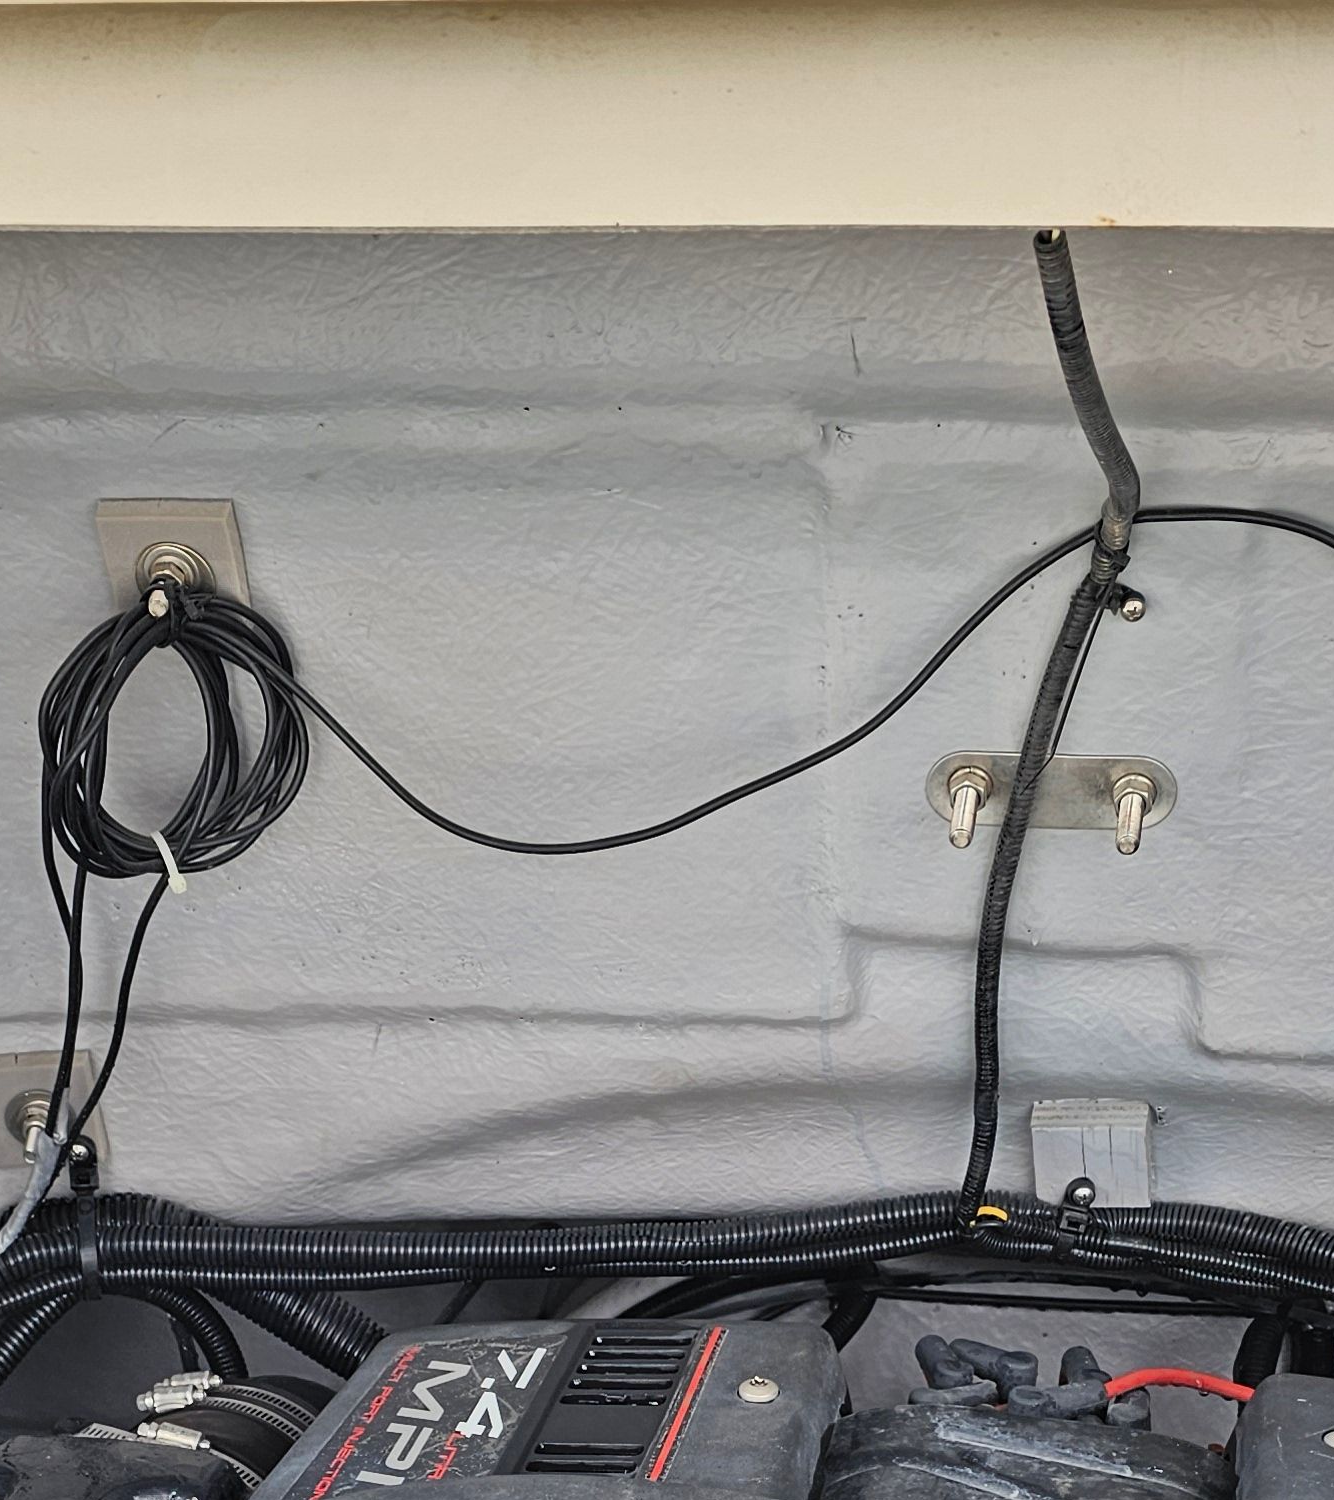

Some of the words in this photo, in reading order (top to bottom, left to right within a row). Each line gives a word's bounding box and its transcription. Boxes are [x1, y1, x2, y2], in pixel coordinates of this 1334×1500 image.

[389, 1345, 422, 1384] MULTI
[365, 1386, 395, 1425] PORT
[455, 1347, 548, 1440] 7.4
[356, 1360, 472, 1487] MPI
[427, 1430, 466, 1481] LITR
